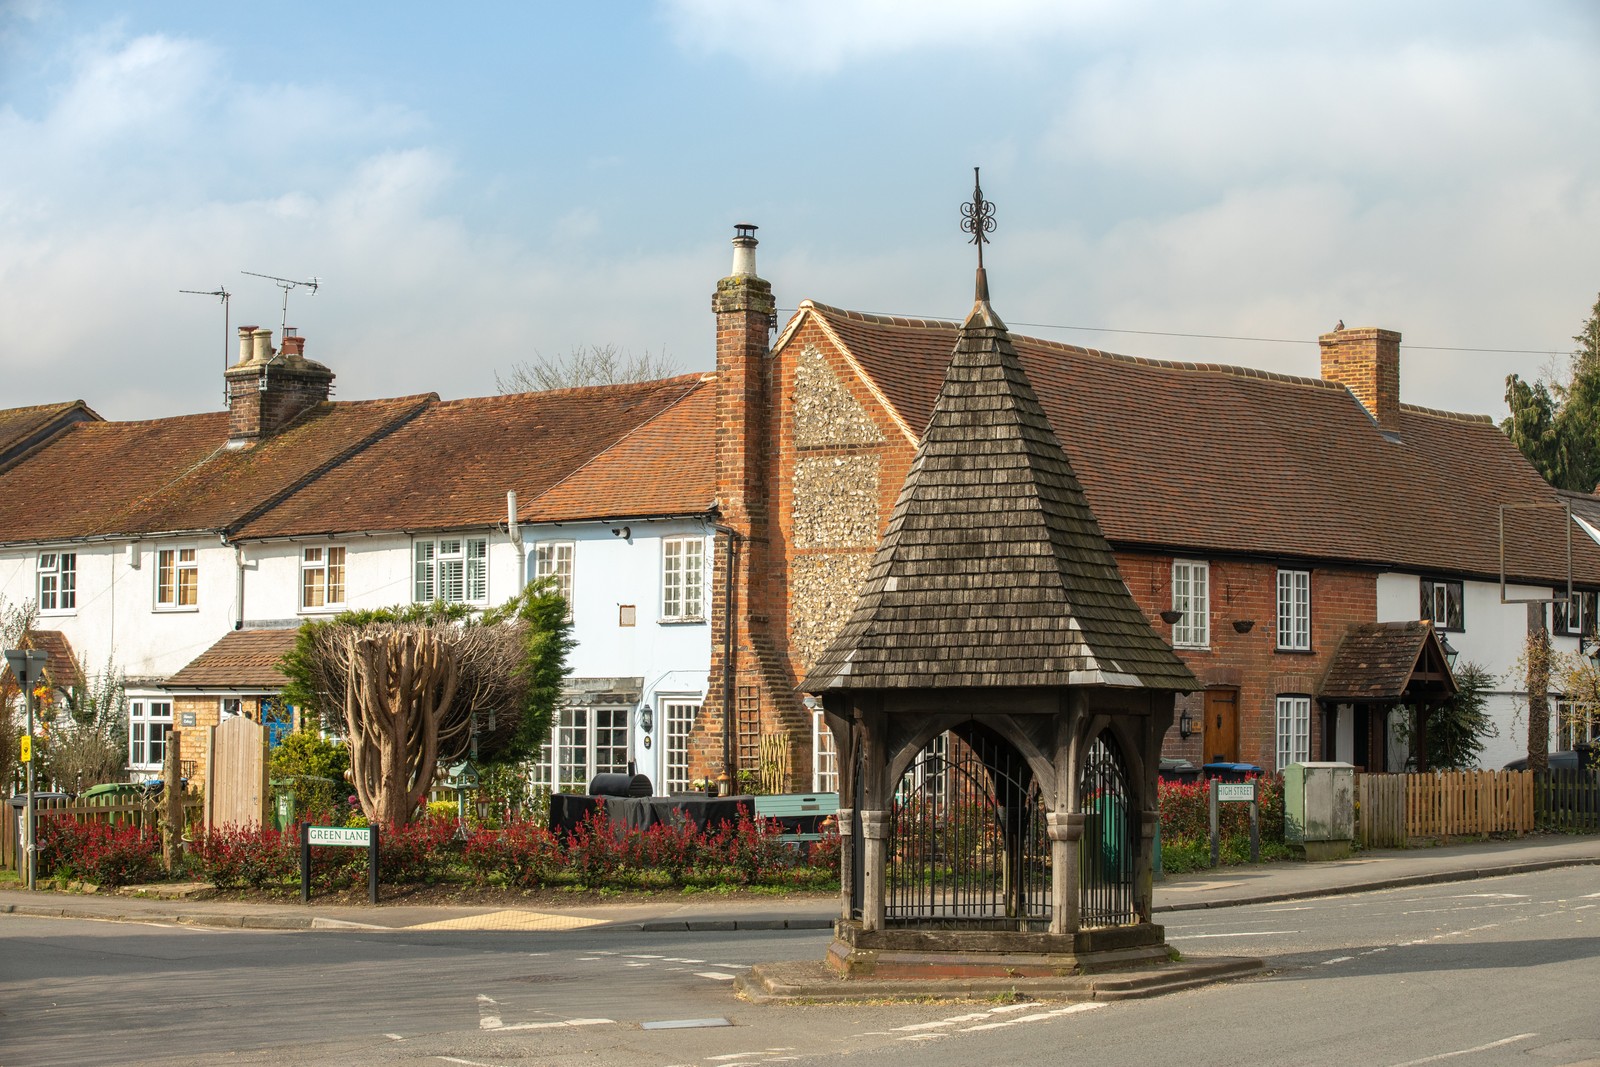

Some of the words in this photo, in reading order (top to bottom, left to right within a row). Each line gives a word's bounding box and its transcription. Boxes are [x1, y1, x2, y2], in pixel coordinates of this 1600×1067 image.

[1218, 786, 1233, 796] HIGH
[1233, 786, 1253, 796] STREET
[310, 829, 342, 840] GREEN
[344, 830, 369, 841] LANE
